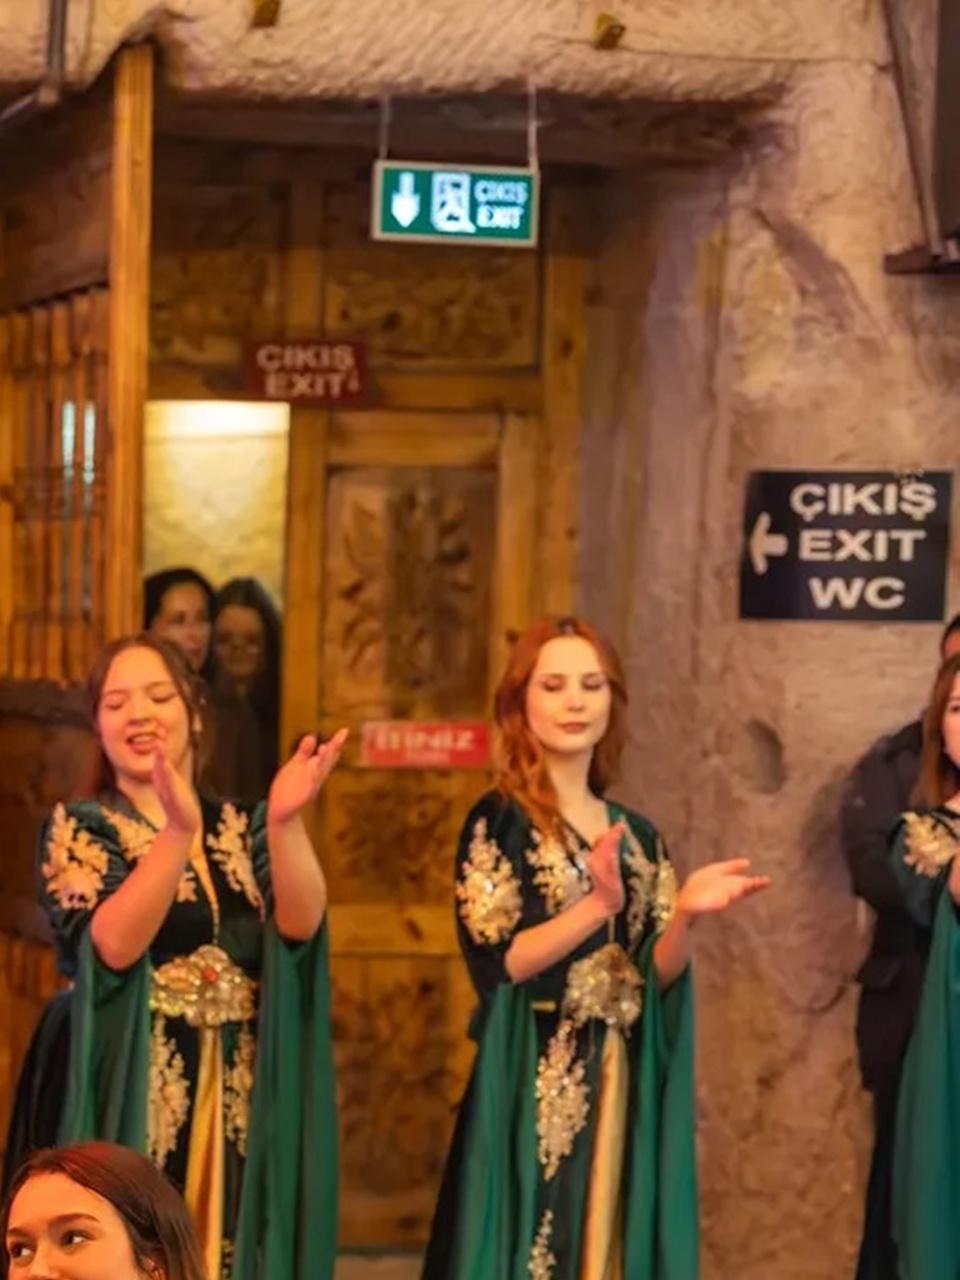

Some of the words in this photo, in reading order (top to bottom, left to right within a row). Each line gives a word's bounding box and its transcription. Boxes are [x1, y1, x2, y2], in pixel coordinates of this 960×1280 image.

[477, 204, 524, 229] EXIT
[265, 372, 346, 398] EXIT
[790, 482, 937, 522] ÇIKIŞ
[798, 528, 927, 562] EXIT
[808, 576, 906, 610] WC
